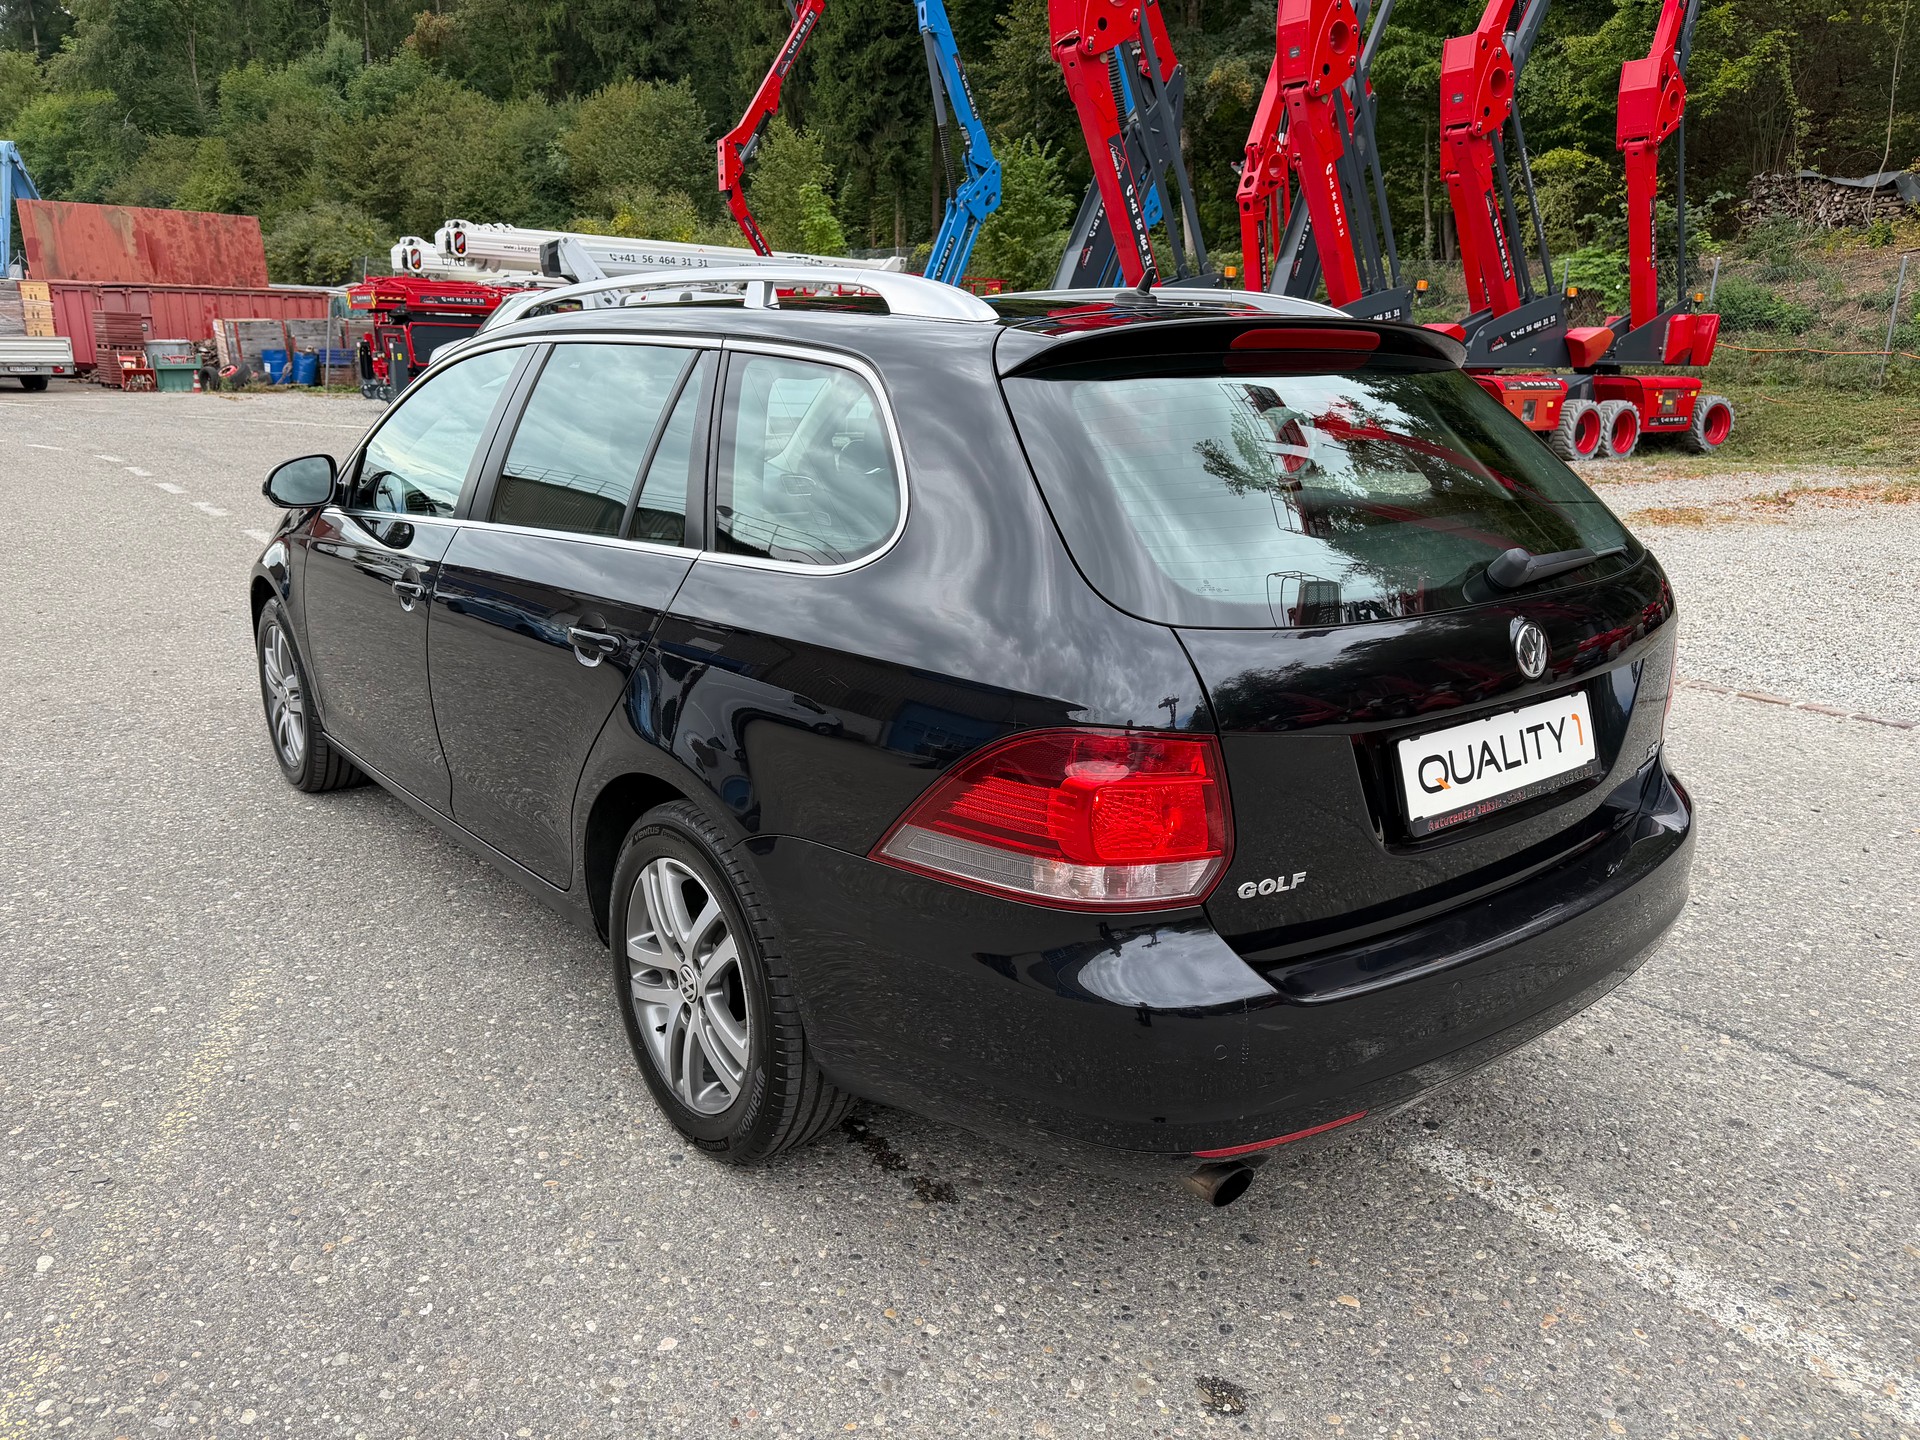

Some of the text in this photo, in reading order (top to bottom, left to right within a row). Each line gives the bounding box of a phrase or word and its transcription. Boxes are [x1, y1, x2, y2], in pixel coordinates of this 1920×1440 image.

[1331, 191, 1337, 201] 56
[1336, 217, 1342, 226] 31
[1339, 227, 1345, 237] 31
[1129, 197, 1139, 215] +41
[1134, 217, 1144, 231] 56
[1139, 233, 1149, 252] 464
[1144, 252, 1153, 267] 31
[619, 254, 708, 267] +41 56 464 31 31
[1384, 311, 1392, 320] 31
[1393, 309, 1400, 317] 31
[1526, 324, 1533, 333] 56
[1237, 871, 1307, 899] GOLF
